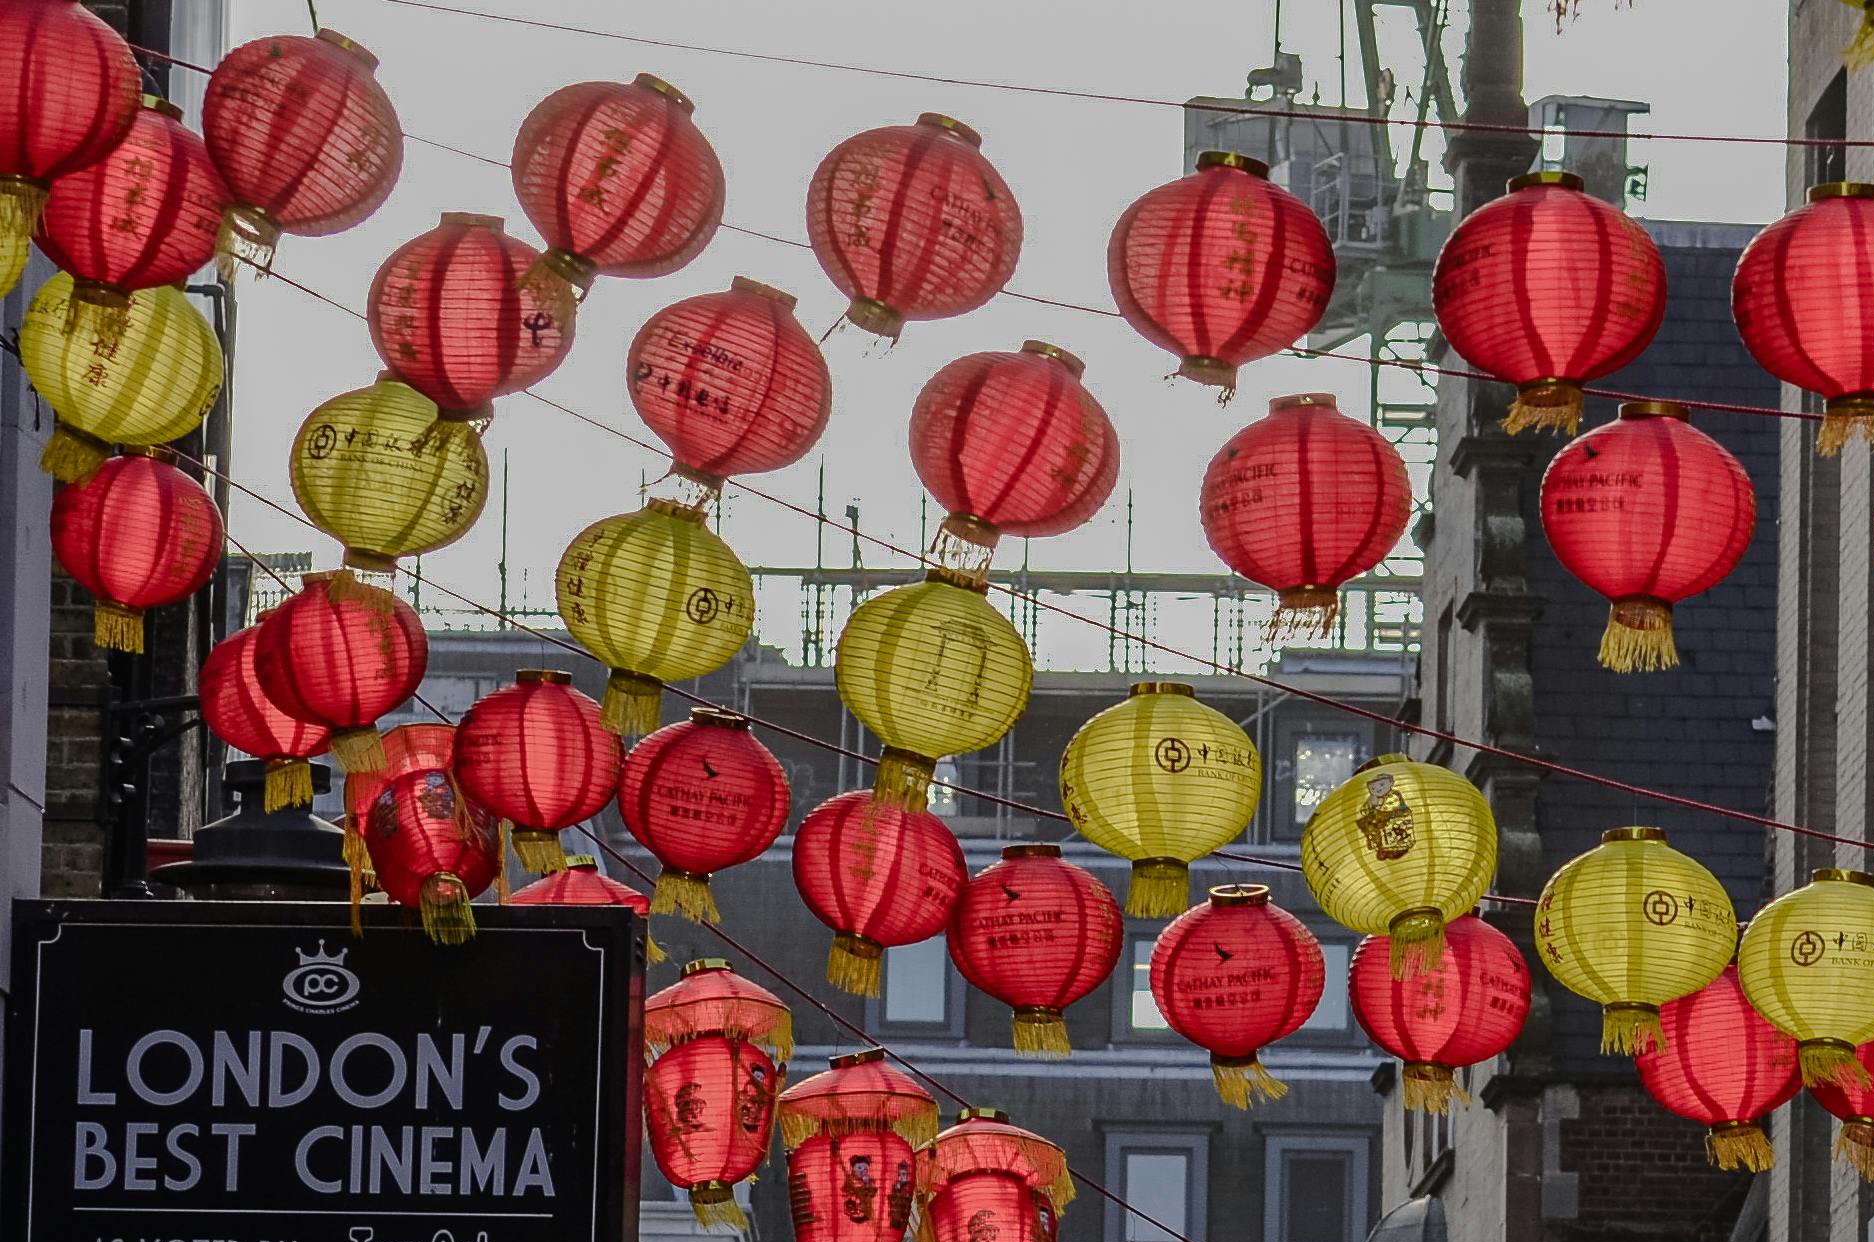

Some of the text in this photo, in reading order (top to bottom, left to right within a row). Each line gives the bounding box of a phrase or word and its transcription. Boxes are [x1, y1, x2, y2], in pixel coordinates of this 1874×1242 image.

[656, 785, 753, 808] CATHAY PACIFIC
[1018, 910, 1064, 925] PACIFIC
[1832, 957, 1860, 967] BANK
[1862, 958, 1874, 968] OF
[1178, 967, 1274, 994] CATHAY PACIFIC
[74, 1121, 556, 1198] BEST CINEMA
